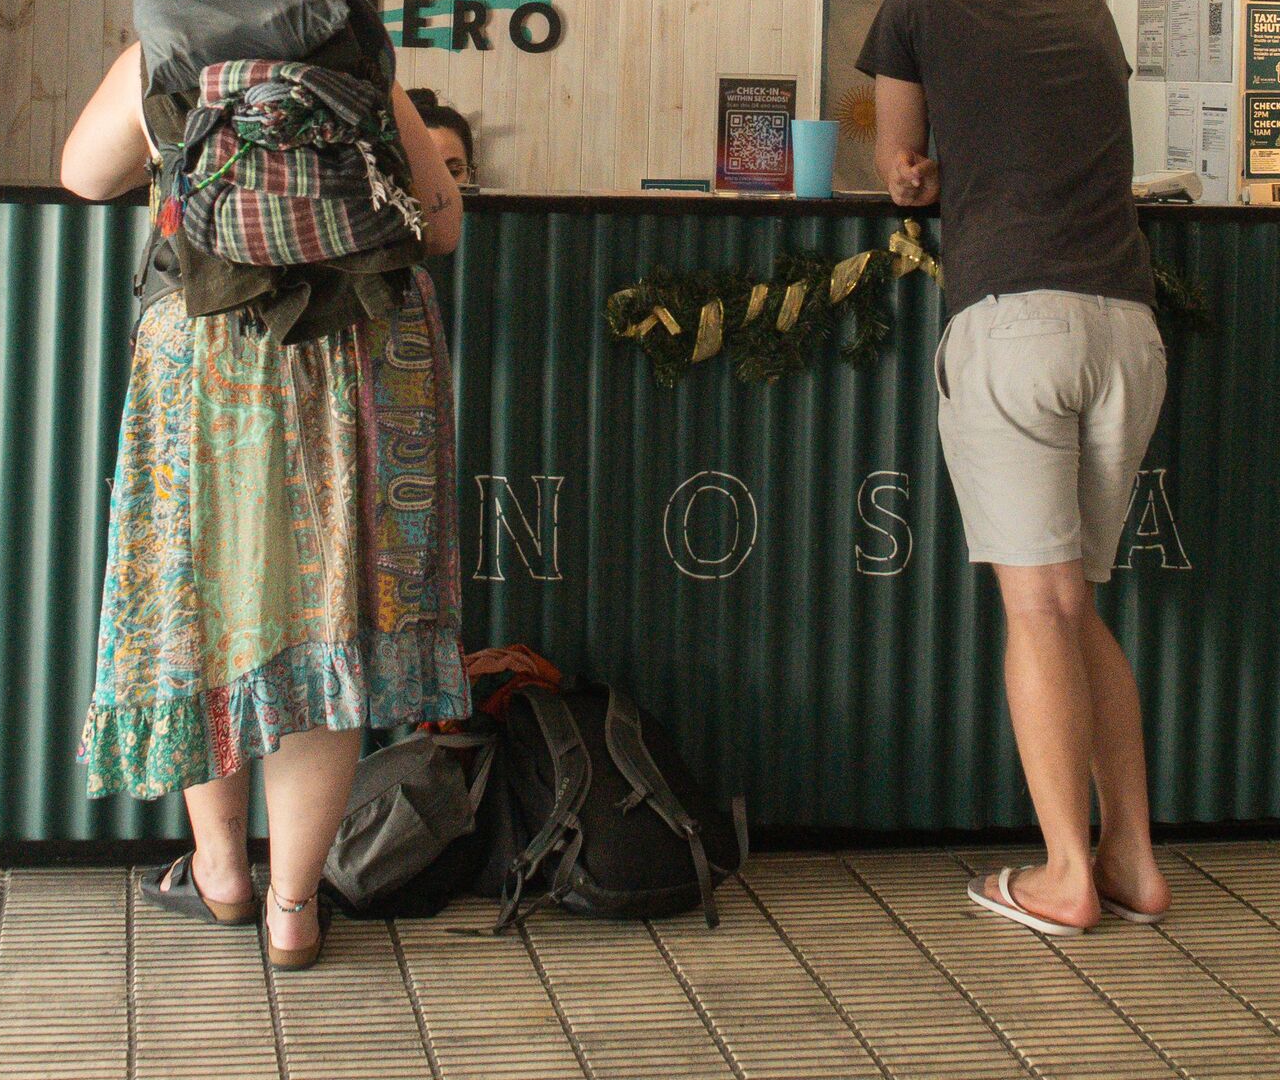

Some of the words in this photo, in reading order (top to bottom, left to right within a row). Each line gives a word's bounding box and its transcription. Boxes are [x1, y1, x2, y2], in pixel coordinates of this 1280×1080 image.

[736, 86, 780, 96] CHECK-IN
[1253, 110, 1269, 118] 2PM
[1253, 128, 1271, 136] 11AM
